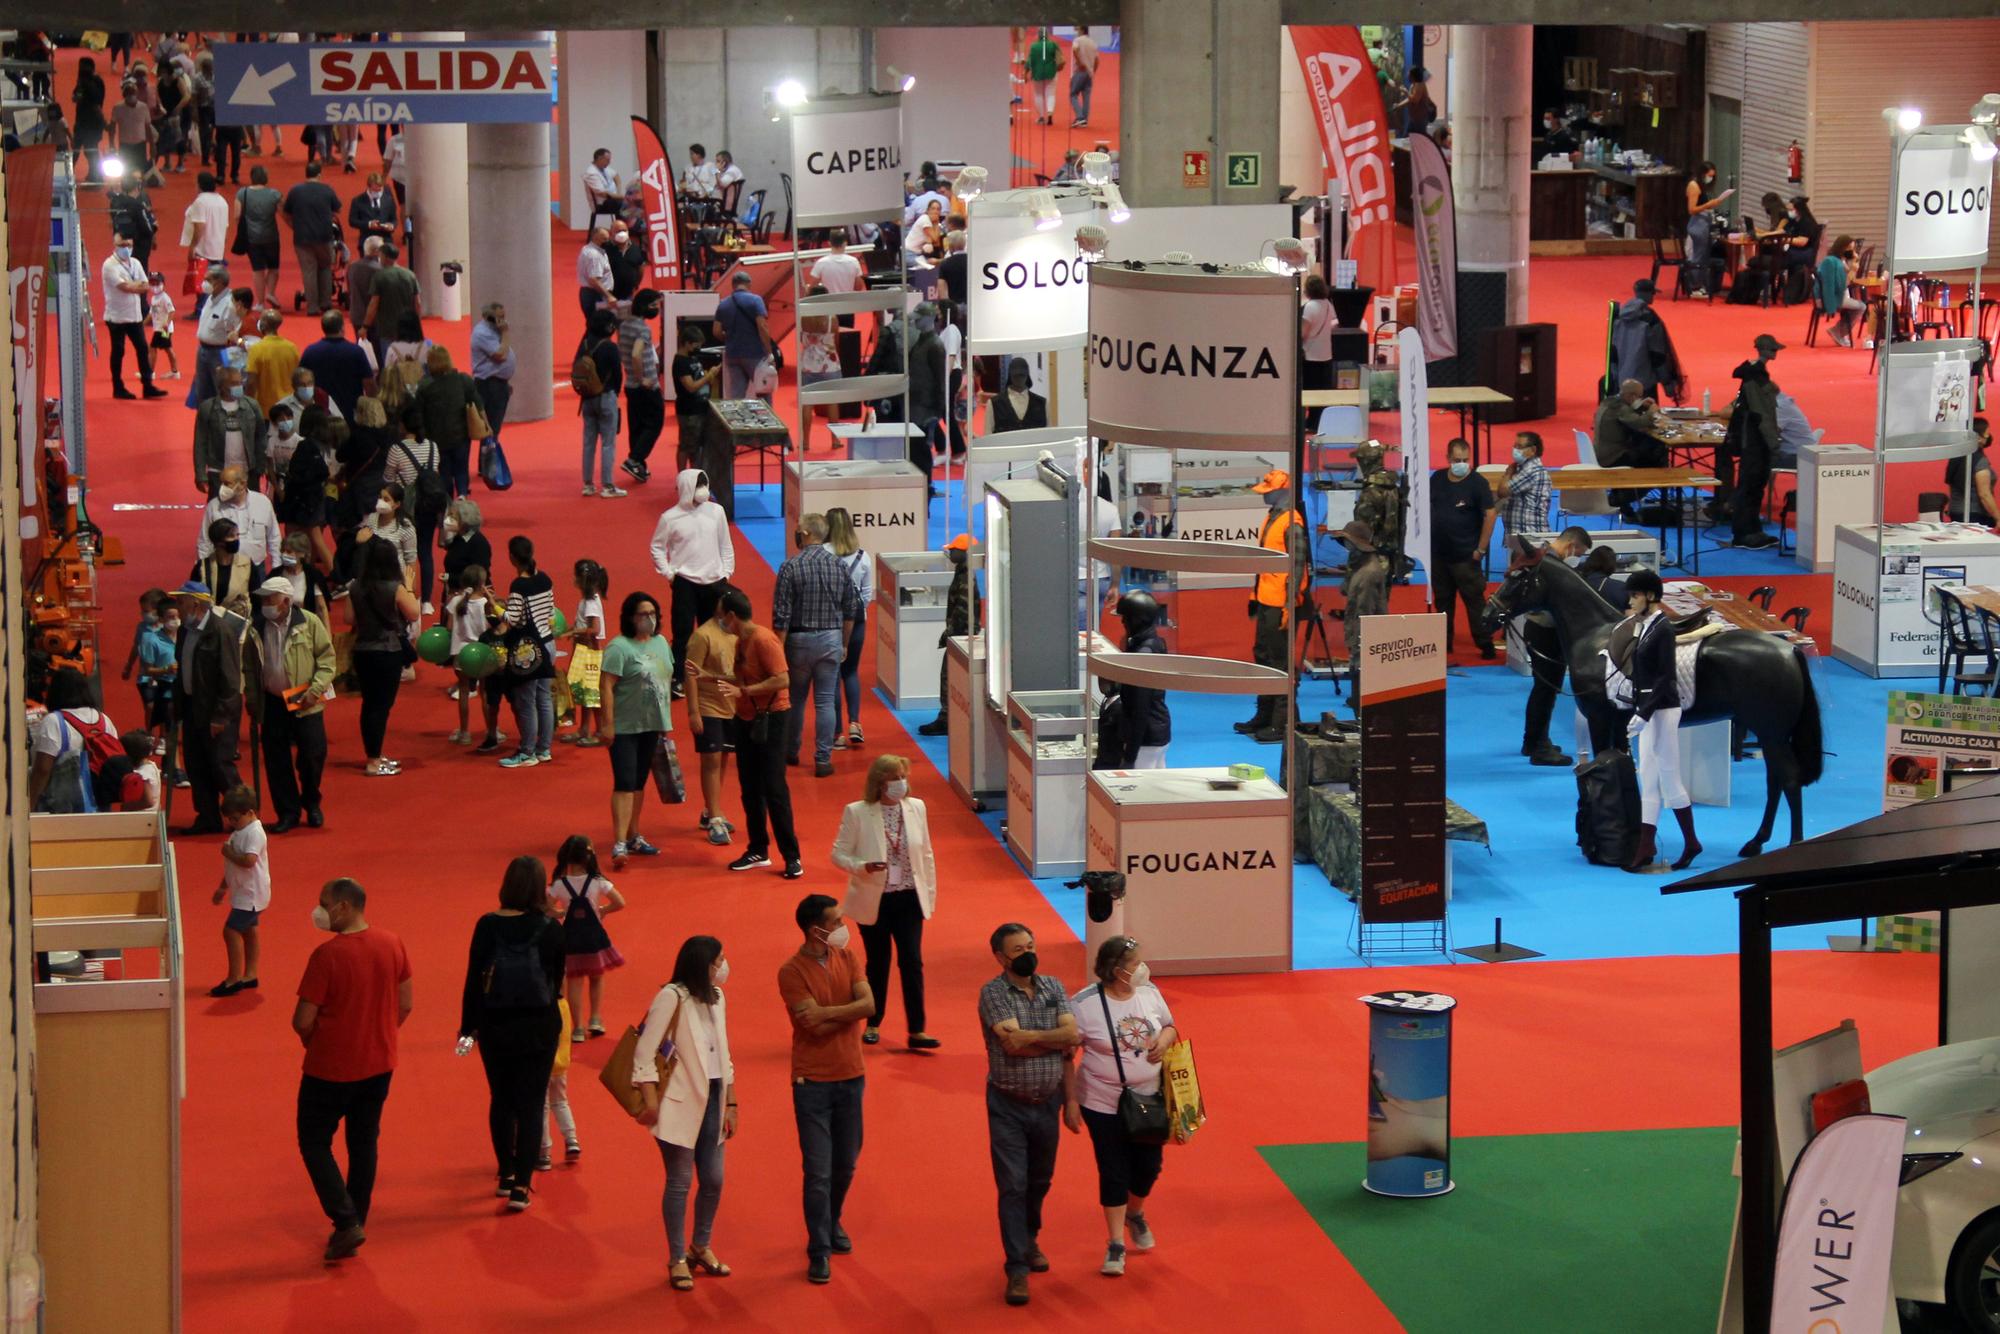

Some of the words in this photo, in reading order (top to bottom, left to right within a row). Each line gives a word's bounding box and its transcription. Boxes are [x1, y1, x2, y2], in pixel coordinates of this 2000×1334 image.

[320, 51, 546, 92] SALIDA
[325, 97, 414, 123] SAÍDA
[1091, 333, 1280, 379] FOUGANZA
[1821, 469, 1871, 478] CAPERLAN
[852, 512, 915, 528] ERLAN
[1181, 528, 1259, 541] APERLAN
[1837, 580, 1875, 612] SOLOGNAC
[1369, 637, 1414, 655] SERVICIO
[1890, 631, 1941, 643] Federaci
[1381, 643, 1437, 664] POSTVENTA
[1922, 645, 1937, 656] de
[1903, 732, 1967, 746] ACTIVIDADES
[1968, 738, 1995, 748] CAZA
[1127, 850, 1277, 875] FOUGANZA
